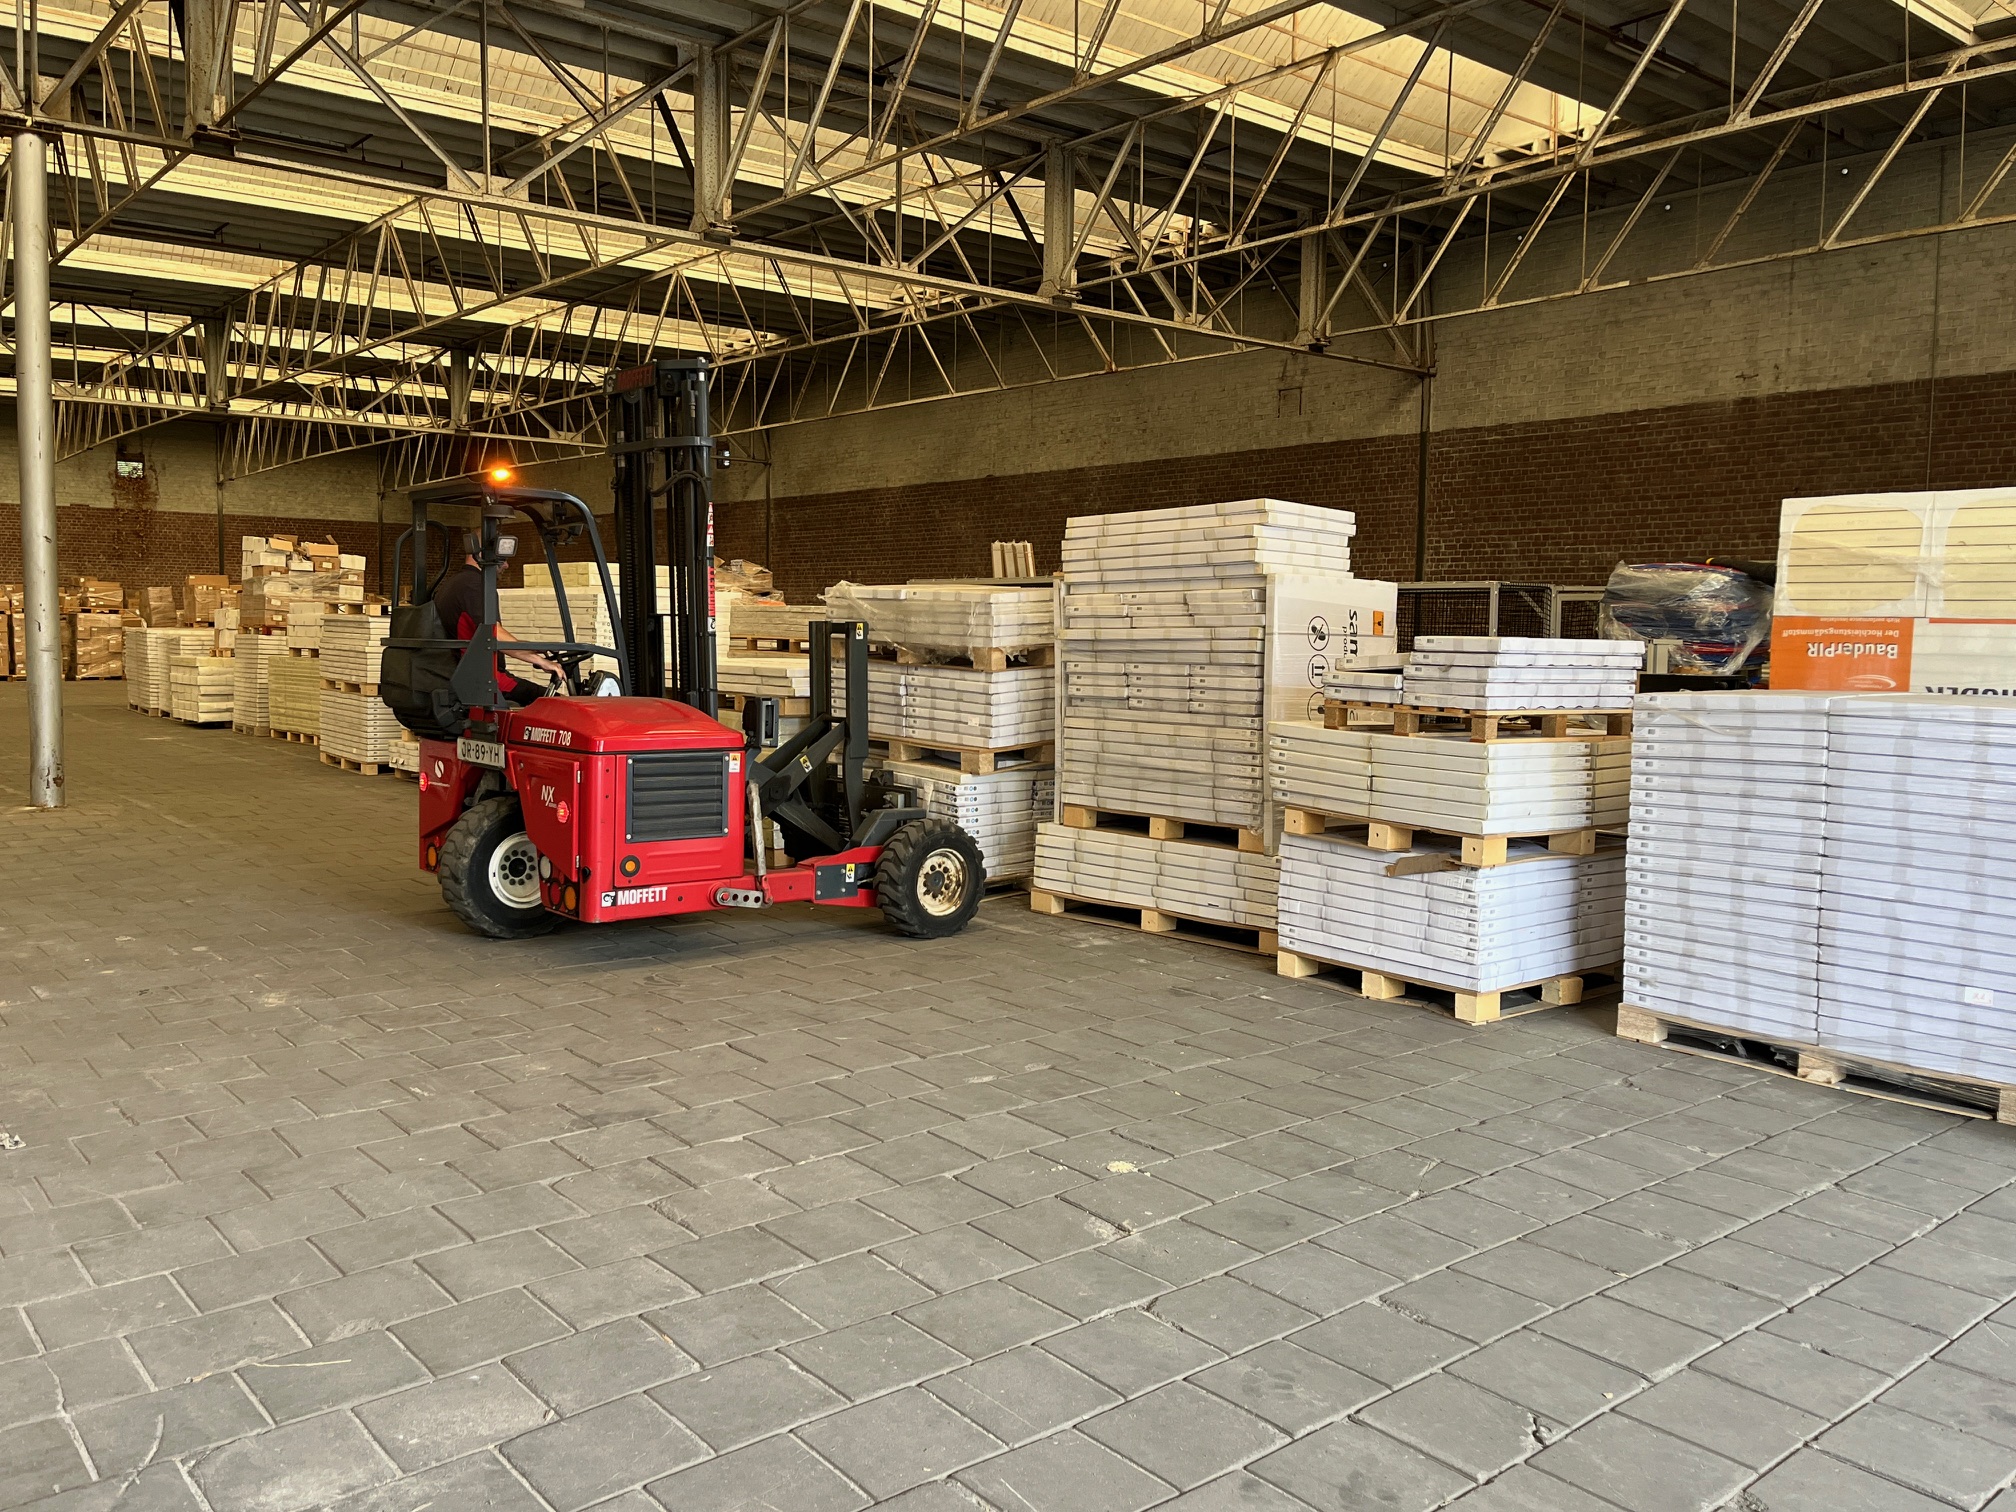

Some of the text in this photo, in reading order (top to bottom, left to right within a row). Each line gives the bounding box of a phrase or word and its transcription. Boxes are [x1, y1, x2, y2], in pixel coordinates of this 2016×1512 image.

[1349, 609, 1358, 657] san
[1782, 627, 1899, 638] Der Hochleistungsdämmstoff
[1807, 641, 1898, 659] BauderPIR
[530, 727, 572, 747] MOFFETT 708
[540, 784, 555, 807] NX
[616, 886, 668, 906] MOFFETT
